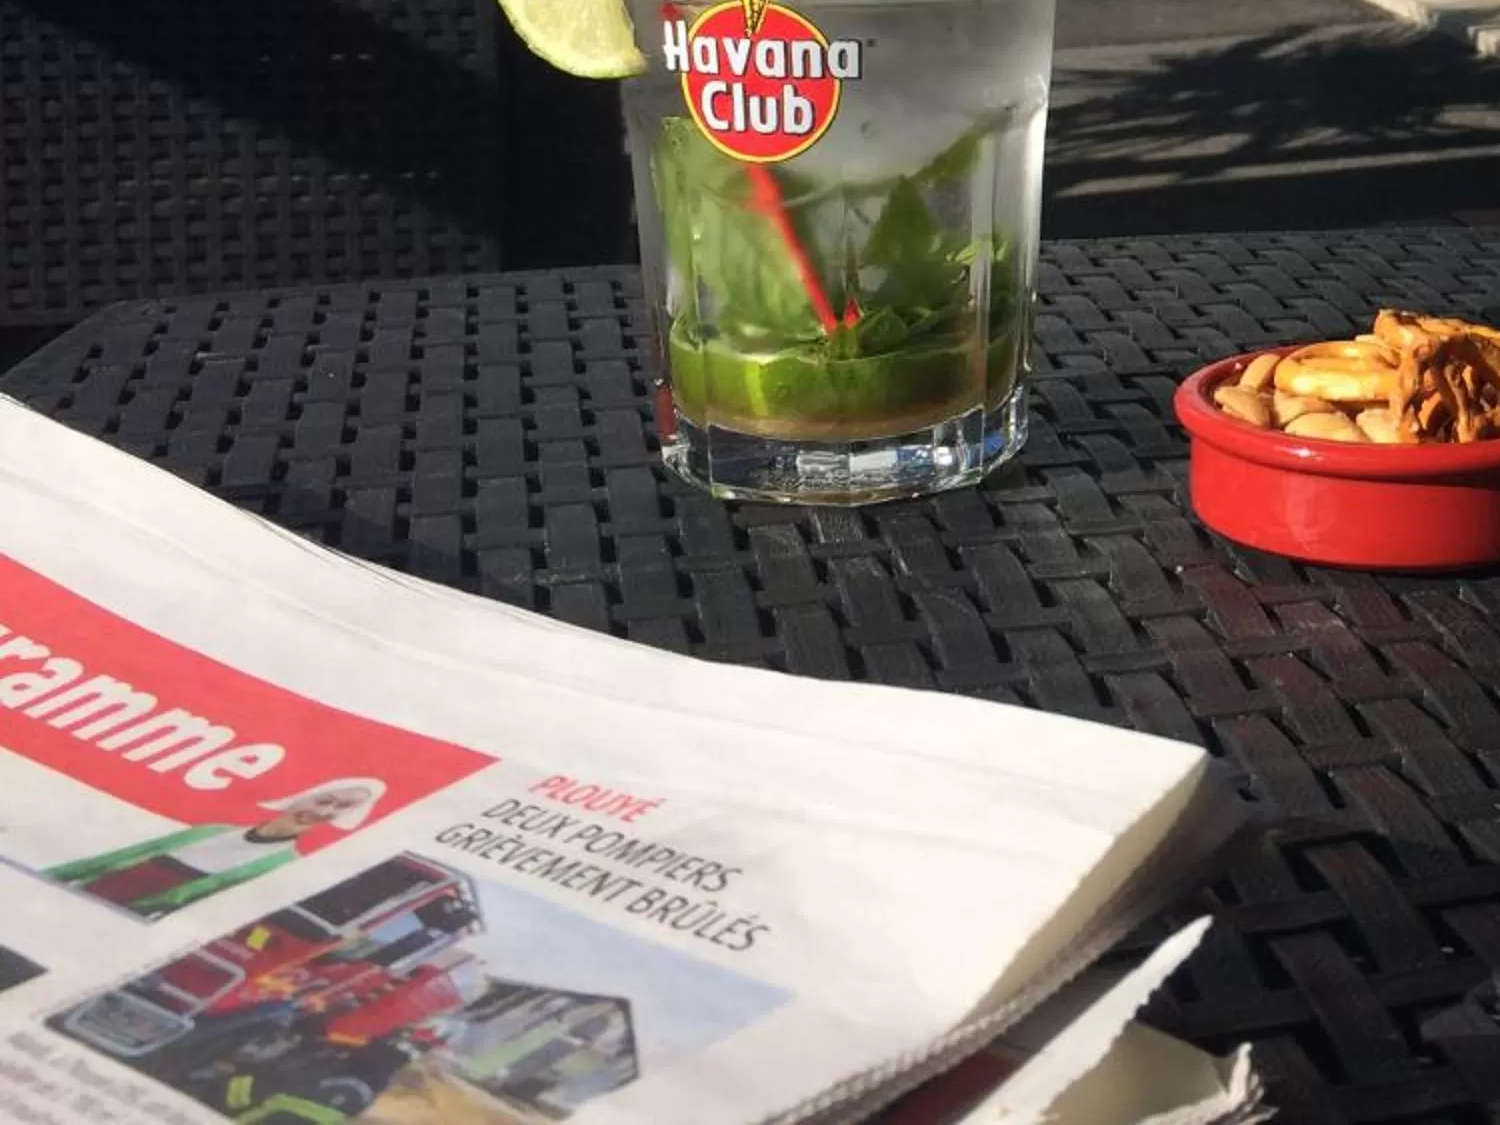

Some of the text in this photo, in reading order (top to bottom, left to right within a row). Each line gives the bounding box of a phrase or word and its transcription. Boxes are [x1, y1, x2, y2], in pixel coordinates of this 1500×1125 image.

[662, 19, 862, 80] Havana
[701, 80, 815, 135] Club
[0, 625, 286, 790] ramme
[528, 774, 667, 824] PLOUYÉ
[481, 798, 743, 894] DEUX POMPIERS
[434, 822, 772, 953] GRIÈVEMENT BRÛLÉS
